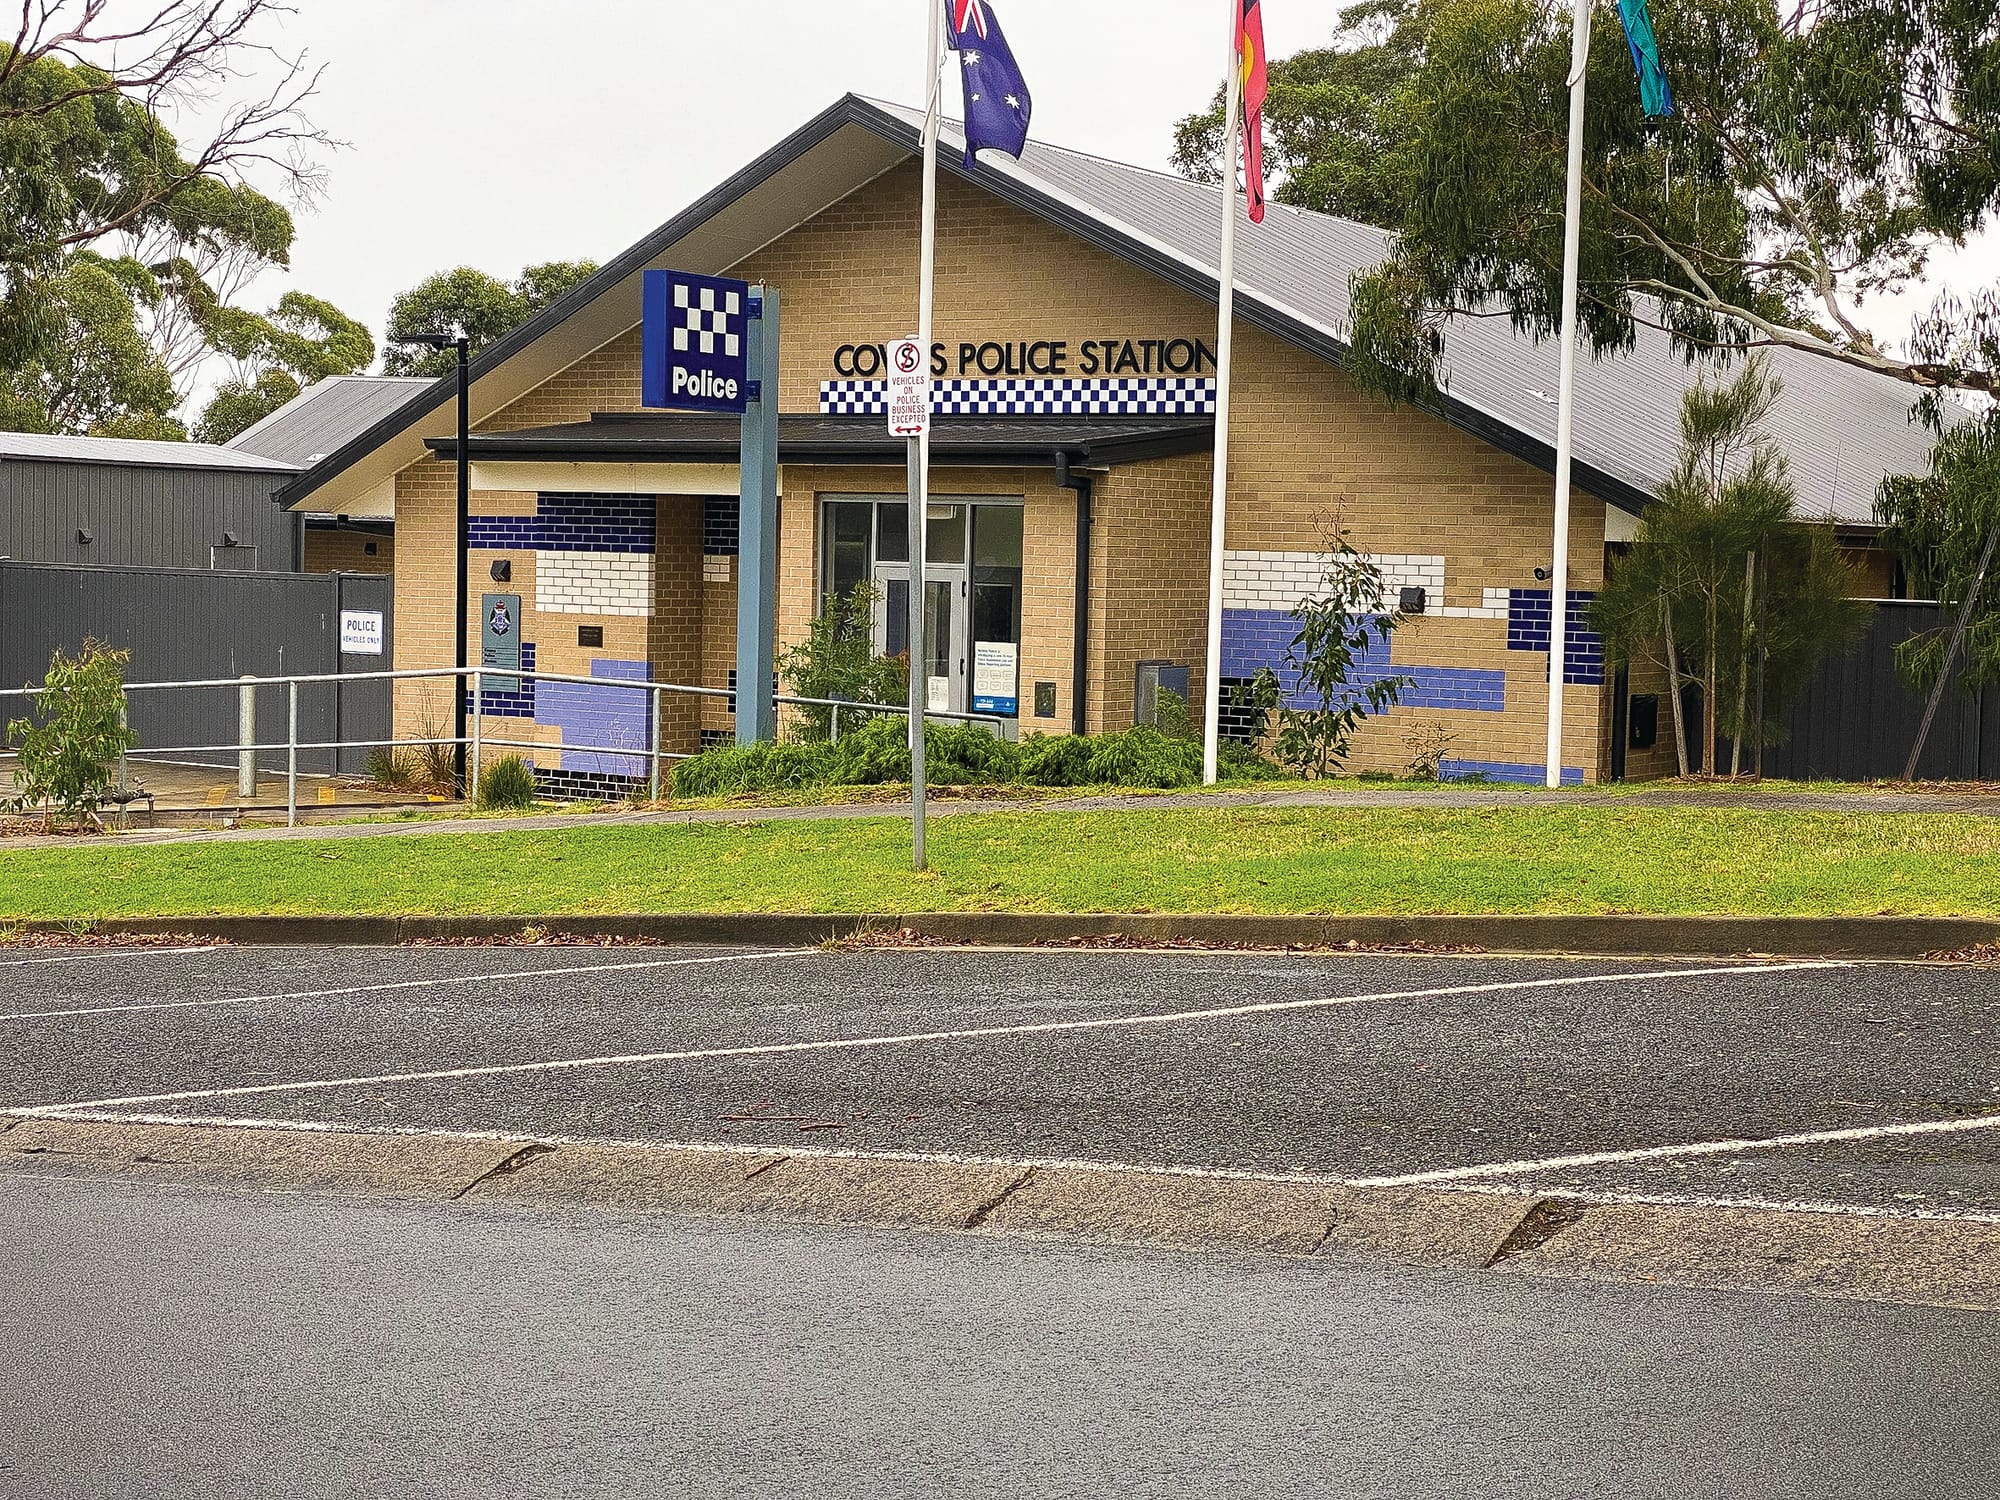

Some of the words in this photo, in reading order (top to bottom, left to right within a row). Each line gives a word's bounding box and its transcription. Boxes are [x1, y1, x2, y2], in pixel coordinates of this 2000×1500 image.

[834, 343, 948, 376] COS
[959, 341, 1067, 374] POLICE
[1079, 339, 1217, 374] STATION
[672, 366, 738, 400] Police
[892, 376, 925, 385] VEHICLES
[896, 396, 920, 404] POLICE
[892, 405, 925, 414] BUSINESS
[892, 414, 926, 423] EXCEPTED
[347, 620, 376, 631] POLICE
